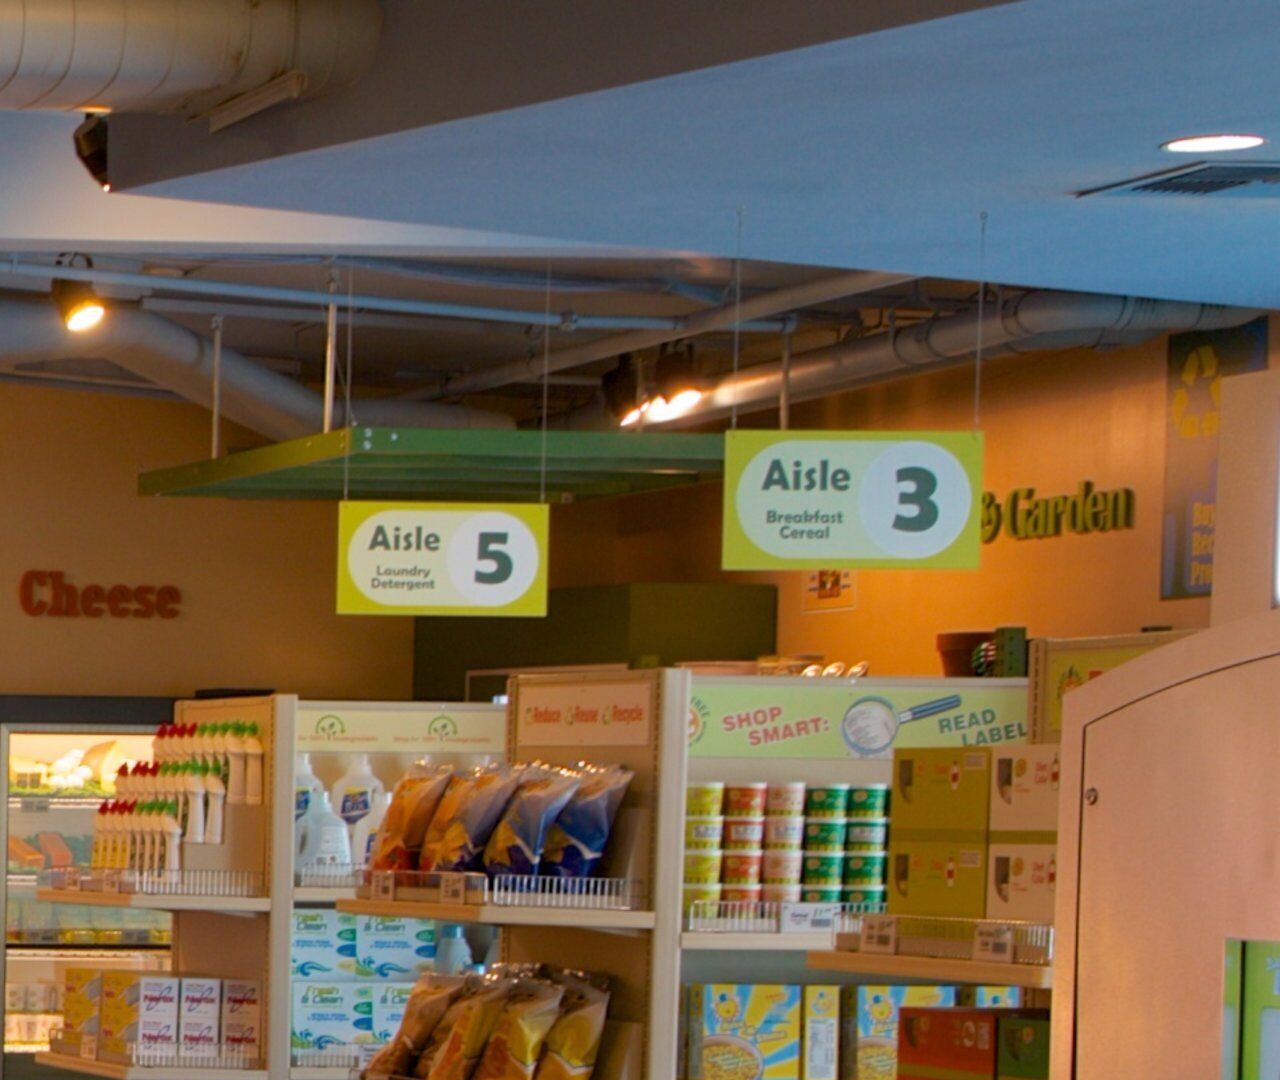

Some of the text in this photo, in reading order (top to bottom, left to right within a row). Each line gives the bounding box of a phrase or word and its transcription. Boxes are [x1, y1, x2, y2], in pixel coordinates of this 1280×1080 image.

[760, 458, 939, 532] Aisle 3
[766, 509, 844, 525] Breakfast
[1005, 481, 1134, 540] Garden
[779, 526, 830, 540] Cereal
[367, 525, 514, 584] Aisle 5
[376, 565, 431, 580] Laundry
[19, 570, 183, 619] Cheese
[370, 577, 436, 591] Detergent
[534, 706, 560, 723] Reduce
[612, 704, 643, 725] Recycle
[722, 706, 782, 731] SHOP
[938, 709, 996, 733] READ
[748, 717, 830, 746] SMART:
[296, 922, 328, 931] Clean
[375, 922, 406, 932] Clean
[312, 995, 344, 1004] Clean
